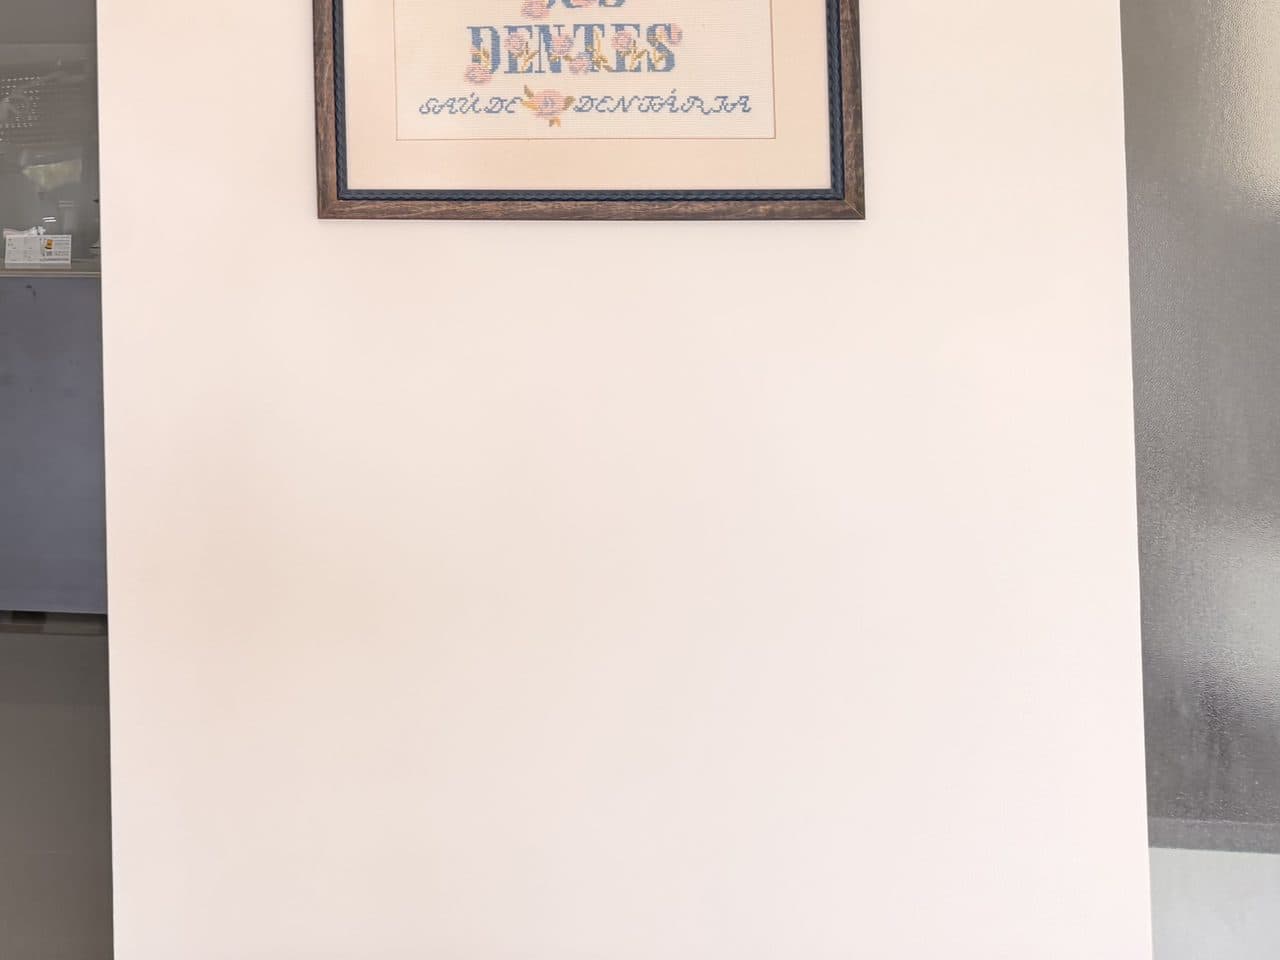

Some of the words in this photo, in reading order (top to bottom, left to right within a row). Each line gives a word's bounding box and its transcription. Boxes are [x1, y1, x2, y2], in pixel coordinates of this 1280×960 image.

[466, 22, 679, 75] DENTES
[418, 92, 522, 115] SAÚDE
[573, 88, 752, 116] DENTÁRIA
